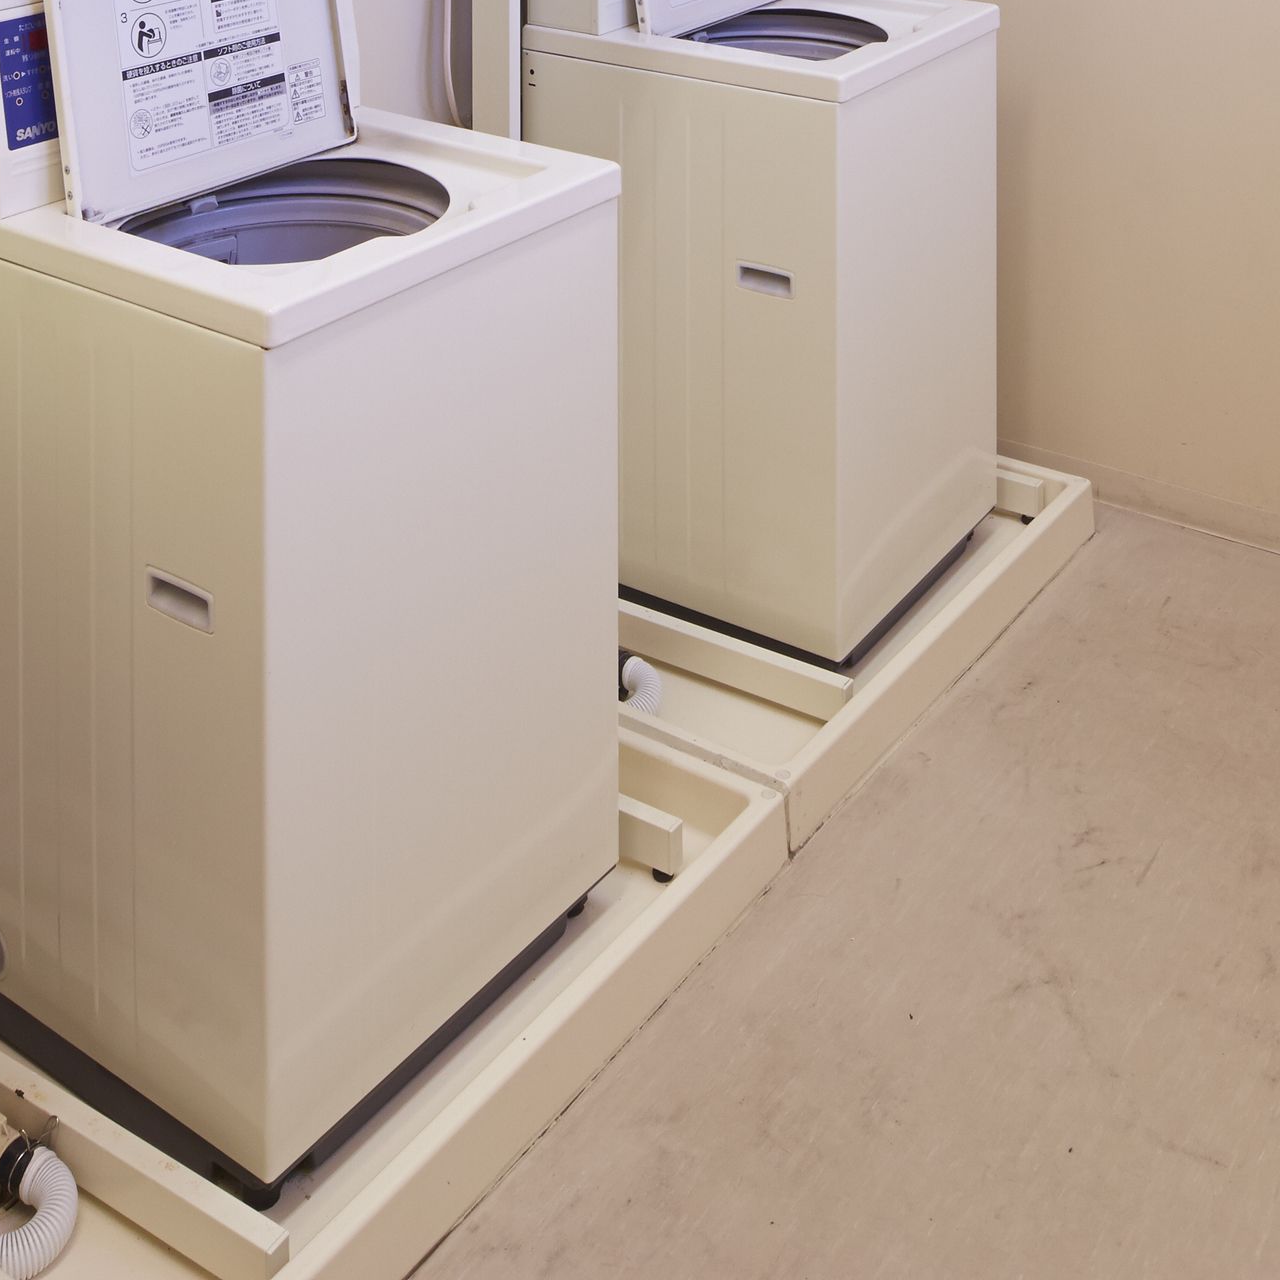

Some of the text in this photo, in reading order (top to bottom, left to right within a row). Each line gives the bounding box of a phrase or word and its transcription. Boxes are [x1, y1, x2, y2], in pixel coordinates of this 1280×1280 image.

[120, 12, 128, 24] 3
[126, 54, 199, 80] 硬貨を投入するときのご注意
[16, 120, 56, 141] SANYO
